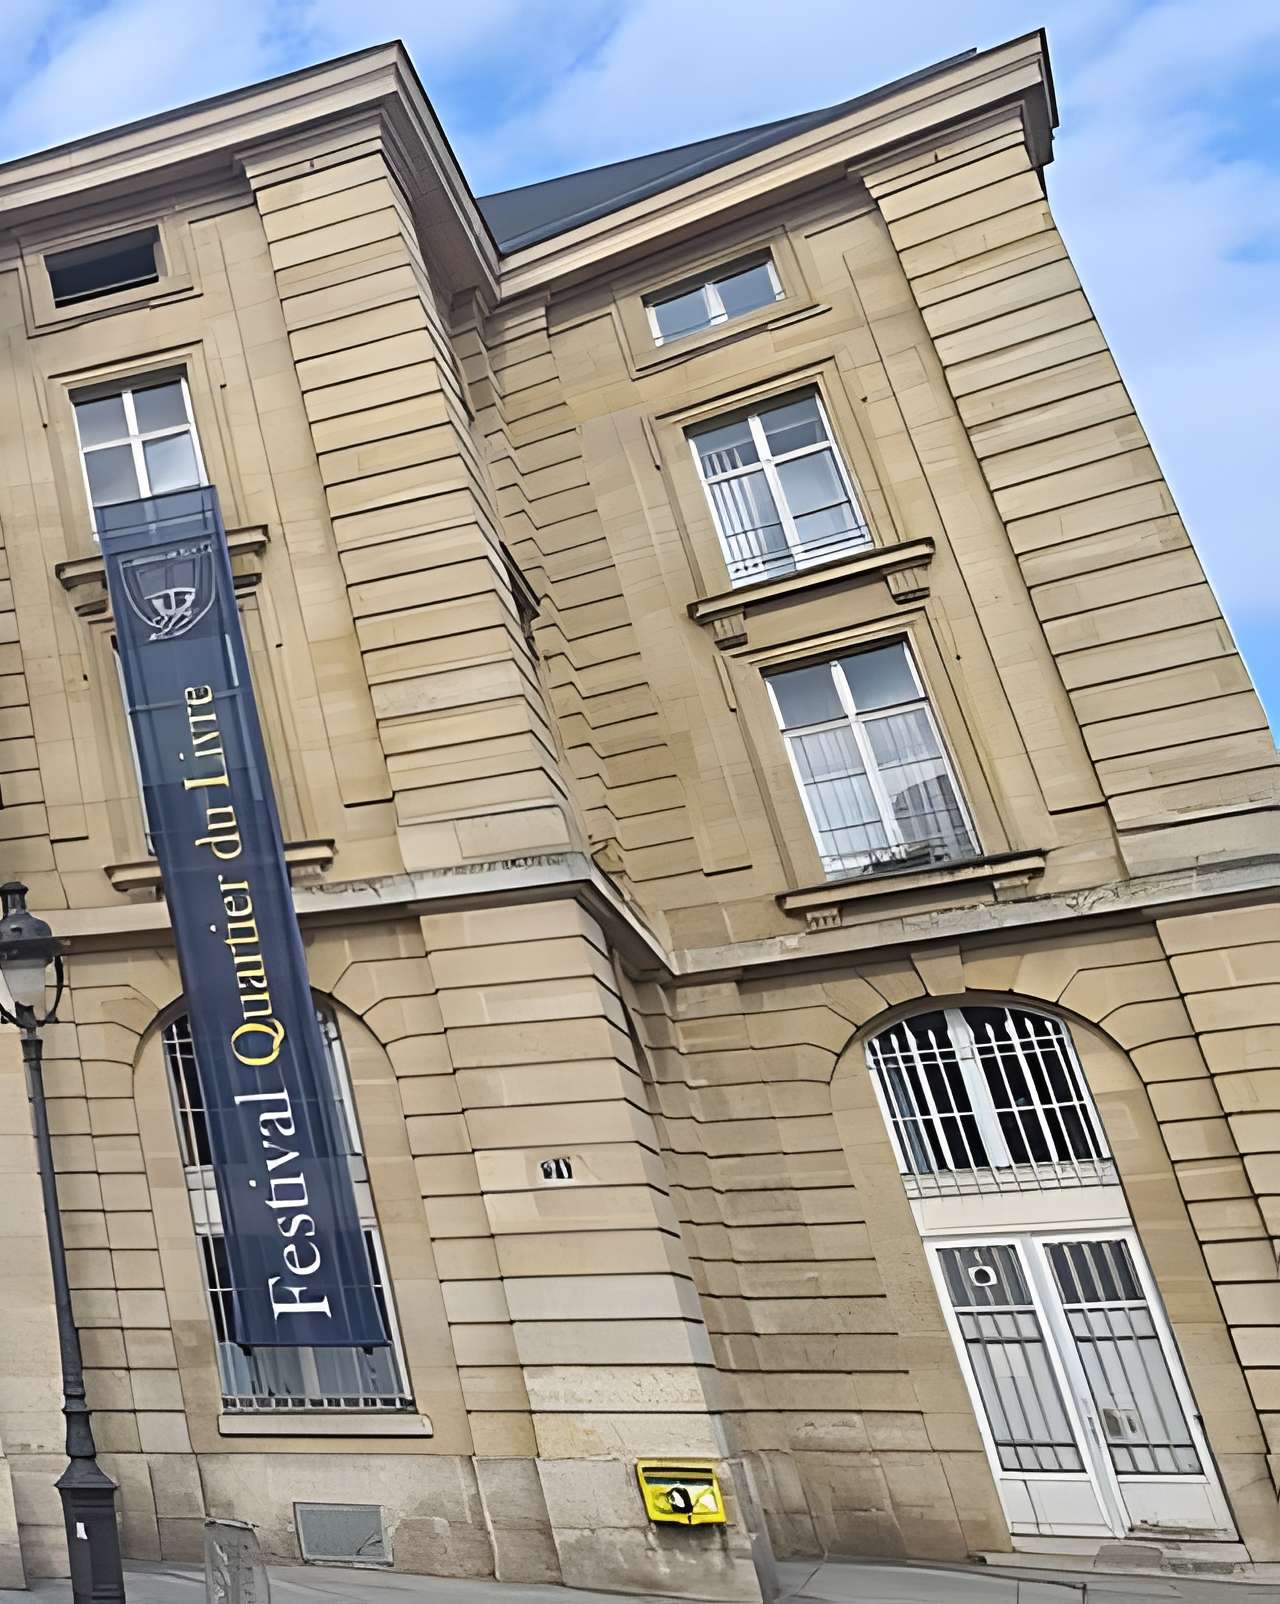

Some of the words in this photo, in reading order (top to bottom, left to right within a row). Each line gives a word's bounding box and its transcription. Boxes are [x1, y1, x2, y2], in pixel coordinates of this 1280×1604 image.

[178, 684, 230, 790] Livre
[194, 804, 242, 860] du
[208, 874, 285, 1067] Quartier
[233, 1086, 333, 1321] Festival
